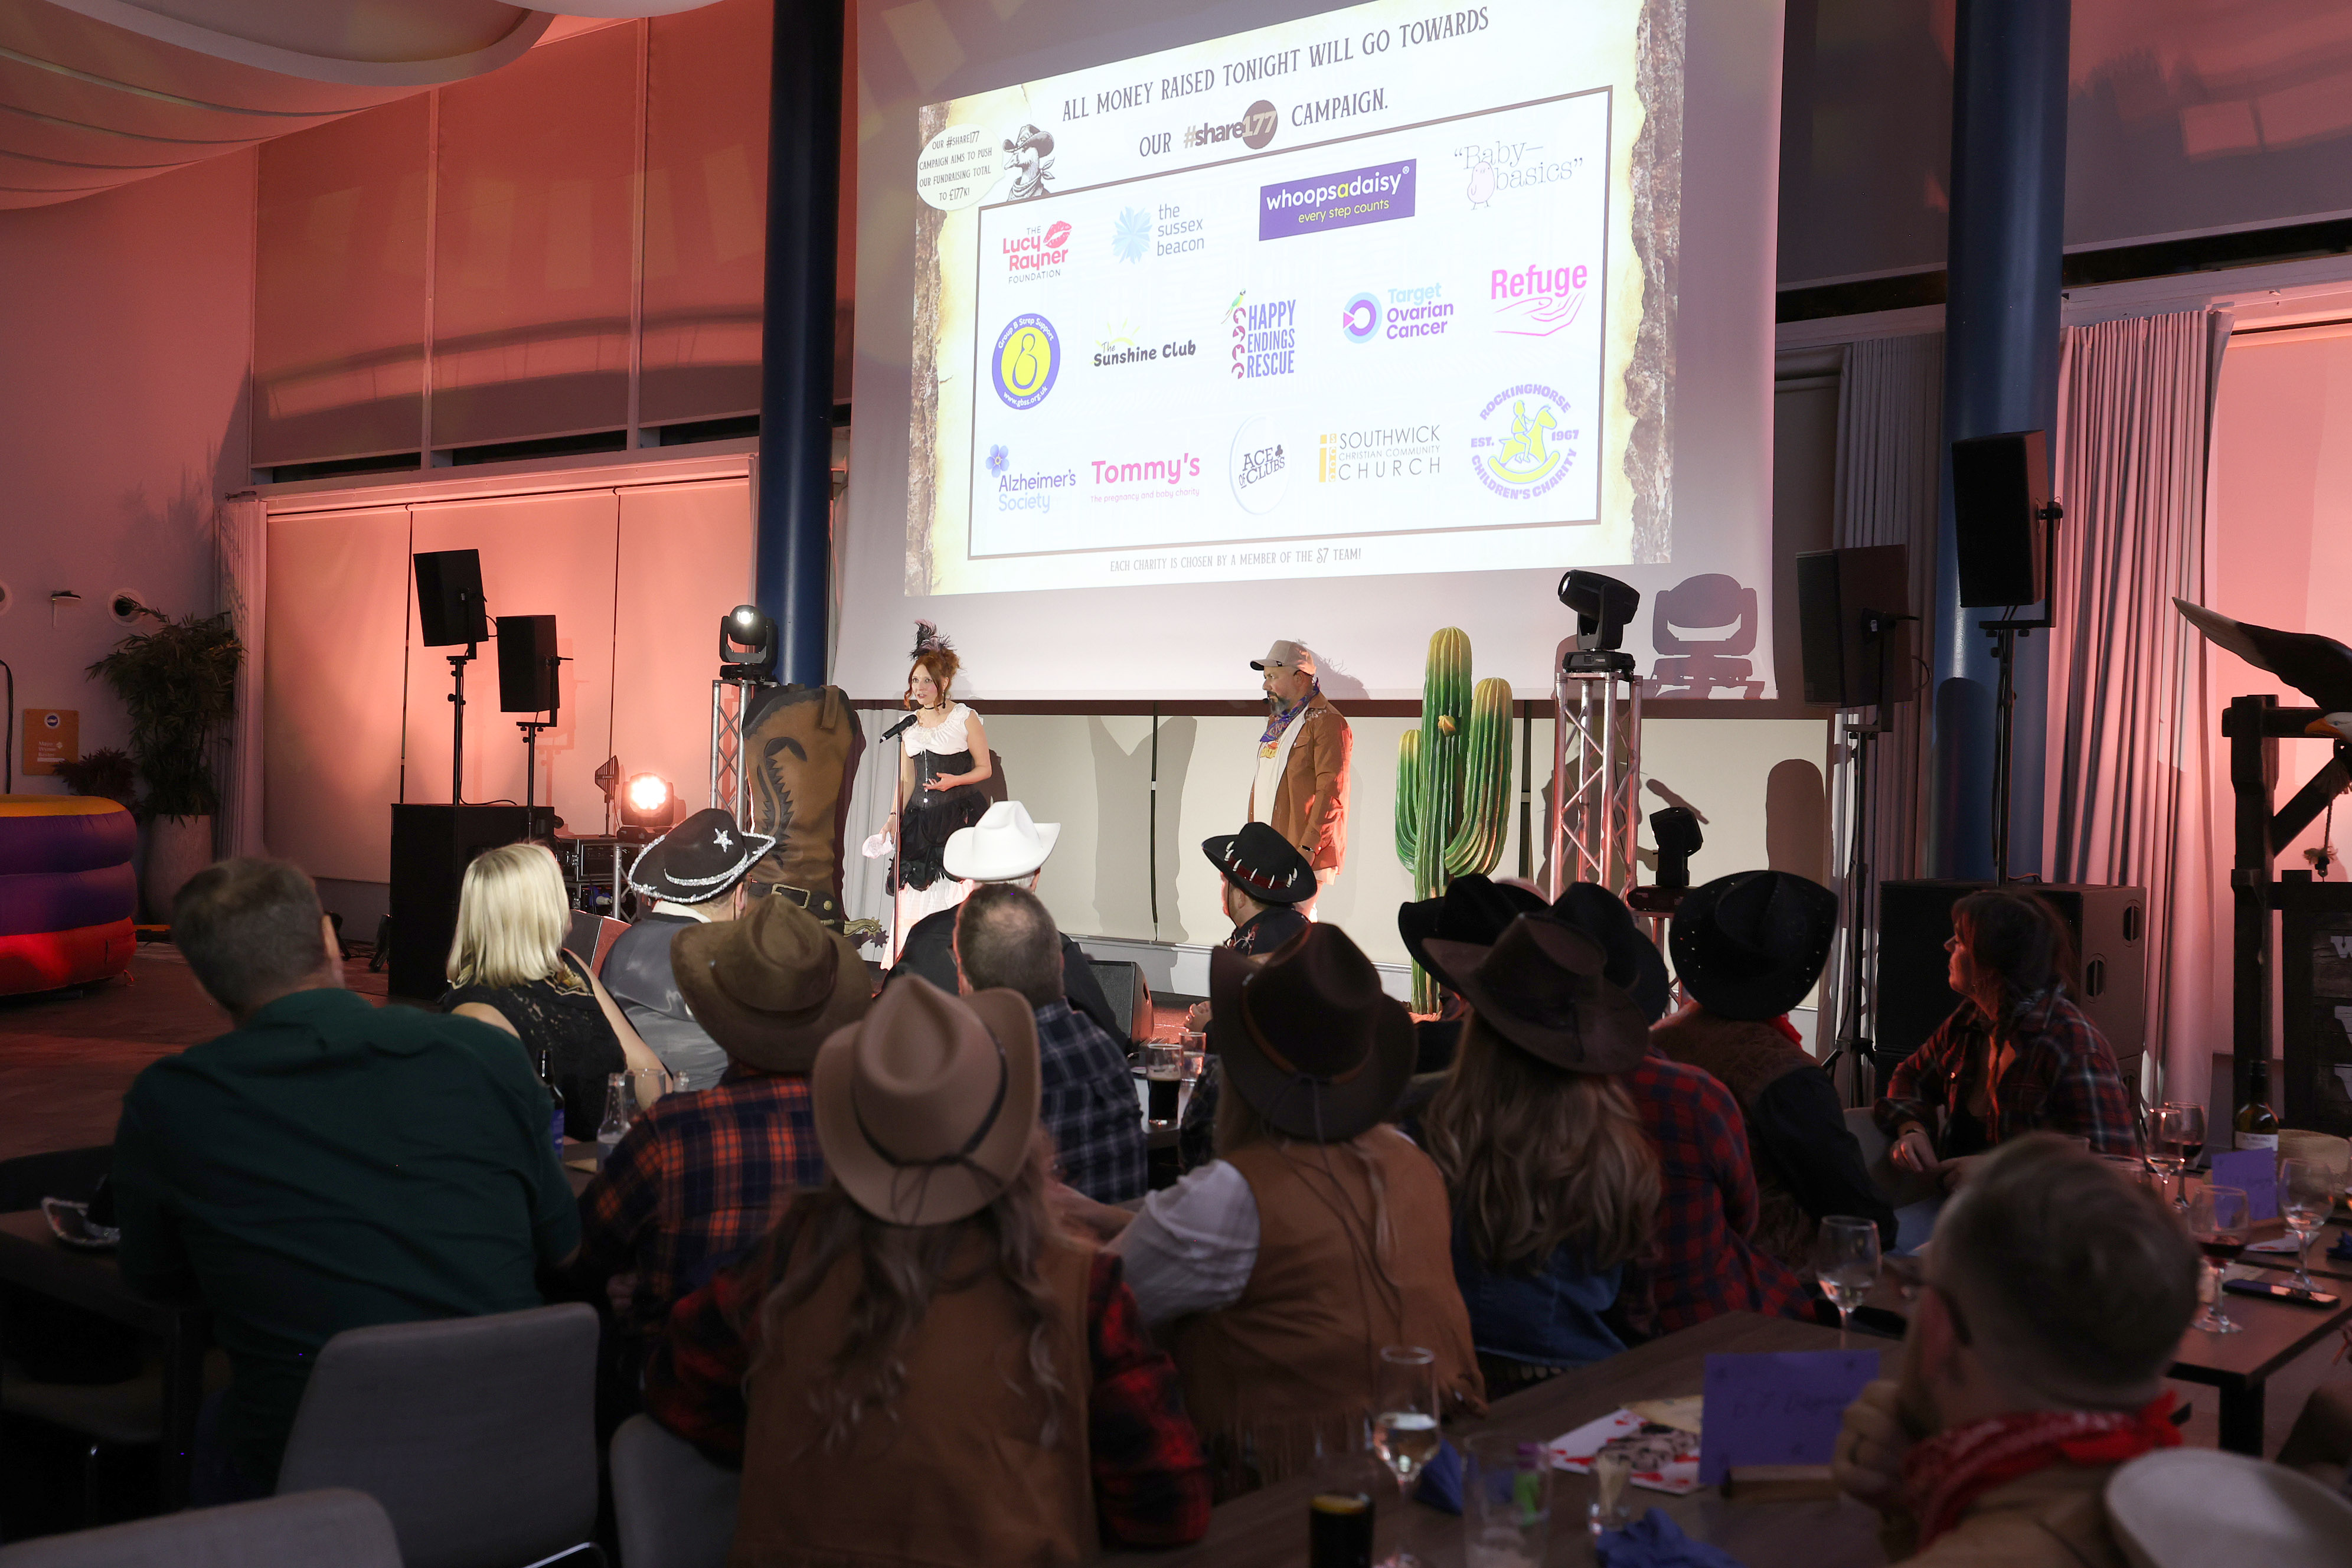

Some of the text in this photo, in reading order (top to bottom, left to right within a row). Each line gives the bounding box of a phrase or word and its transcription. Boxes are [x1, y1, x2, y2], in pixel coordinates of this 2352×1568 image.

[1063, 6, 1489, 122] ALL MONEY RAISED TONIGHT WILL GO TOWARDS
[1139, 132, 1171, 157] OUR
[1292, 87, 1388, 127] CAMPAIGN.
[932, 130, 980, 150] OUR #SHARE177
[919, 146, 992, 171] CAMPAIGN AIMS TO PUSH
[919, 165, 991, 188] OUR FUNDRAISING TOTAL
[939, 187, 970, 201] TO £177K!
[1158, 203, 1180, 220] the
[1298, 199, 1390, 223] every step counts
[1026, 226, 1041, 235] THE
[1158, 218, 1203, 237] sussex
[1003, 235, 1041, 254] Lucy
[1157, 237, 1204, 256] beacon
[1009, 248, 1069, 272] Rayner
[1008, 269, 1061, 284] FOUNDATION
[1491, 264, 1587, 300] Refuge
[1387, 282, 1442, 306] Target
[1249, 299, 1296, 331] HAPPY
[1387, 300, 1454, 323] Ovarian
[998, 318, 1054, 349] Group B Strep Support
[1247, 328, 1295, 354] ENDINGS
[1386, 321, 1448, 340] Cancer
[1094, 339, 1196, 367] Sunshine Club
[1101, 341, 1116, 354] The
[1247, 349, 1295, 378] RESCUE
[1003, 386, 1048, 407] www.gbss.org.uk
[1479, 383, 1572, 421] ROCKINGHORSE
[1340, 424, 1440, 450] SOUTHWICK
[1471, 429, 1580, 448] EST. 1967
[1242, 447, 1273, 472] ACE
[1338, 445, 1440, 461] CHRISTIAN COMMUNITY
[998, 468, 1076, 492] Alzheimer's
[1091, 452, 1200, 485] Tommy's
[1246, 456, 1285, 484] CLUBS
[1338, 456, 1440, 481] CHURCH
[1471, 447, 1577, 500] CHILDREN'S CHARITY
[998, 492, 1050, 514] Society
[1103, 492, 1139, 503] pregnancy
[1141, 491, 1154, 499] and
[1155, 488, 1174, 499] baby
[1175, 487, 1200, 497] charity
[1110, 560, 1130, 571] EACH
[1133, 558, 1167, 570] CHARITY
[1171, 557, 1178, 569] IS
[1181, 556, 1213, 568] CHOSEN
[1217, 555, 1227, 566] BY
[1231, 554, 1236, 566] A
[1240, 552, 1276, 565] MEMBER
[1280, 551, 1292, 563] OF
[1295, 550, 1313, 562] THE
[1333, 547, 1361, 561] TEAM!
